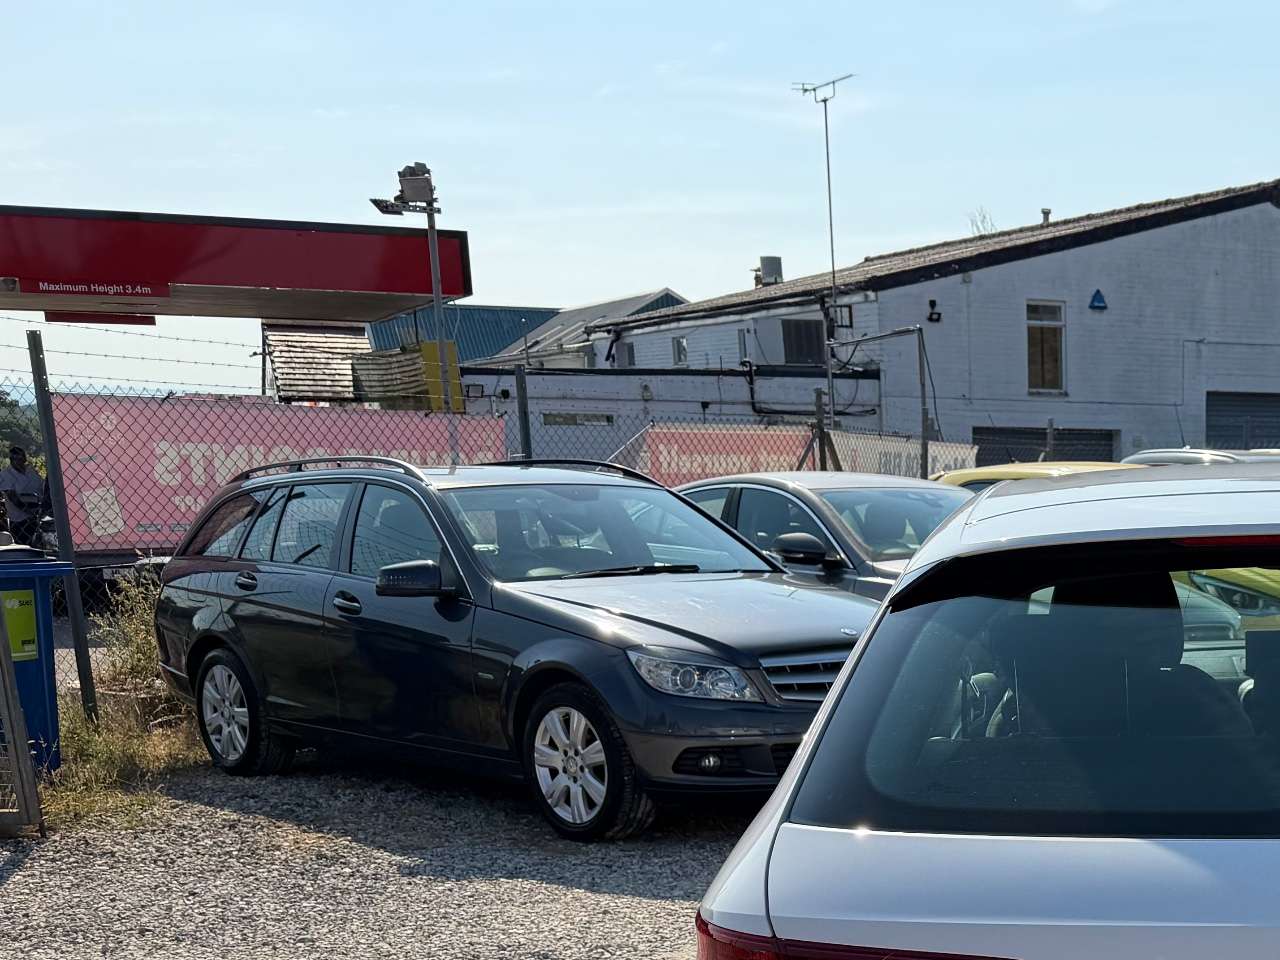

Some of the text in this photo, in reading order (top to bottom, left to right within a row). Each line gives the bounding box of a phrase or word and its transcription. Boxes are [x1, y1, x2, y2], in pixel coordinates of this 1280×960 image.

[38, 281, 152, 295] Maximum Height 3.4m
